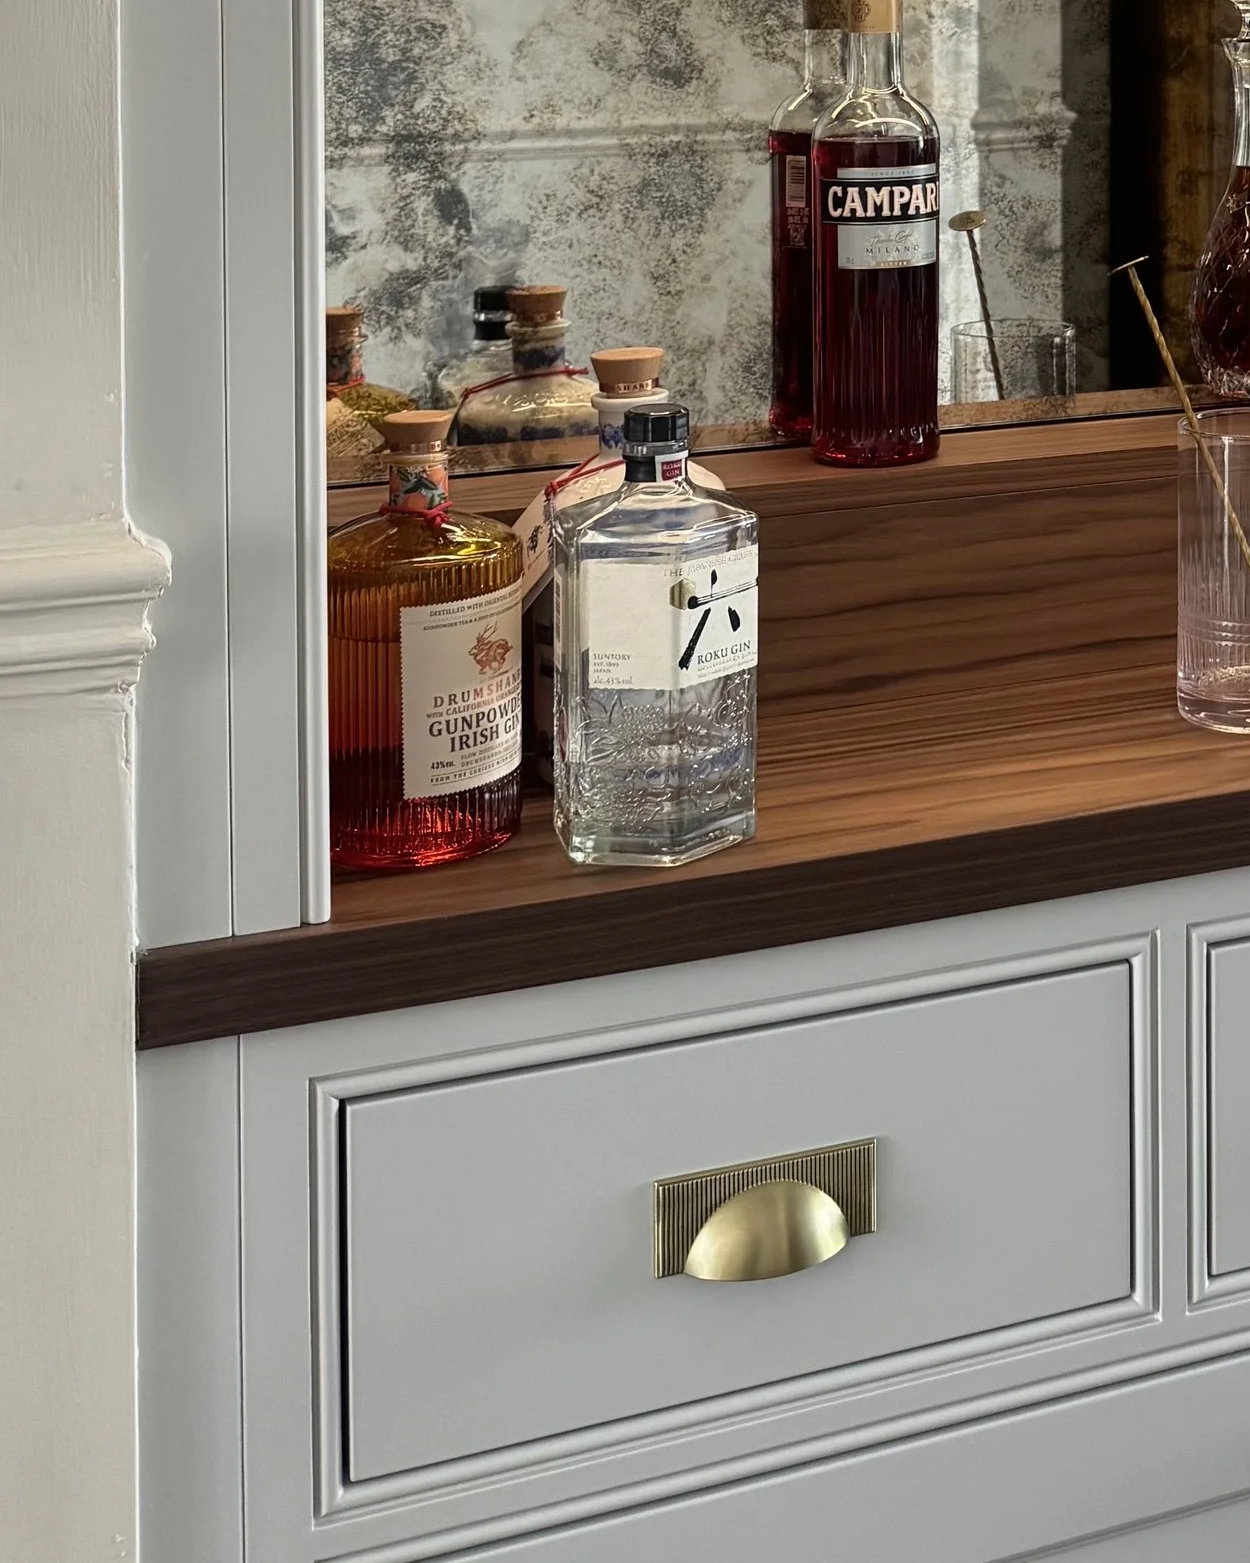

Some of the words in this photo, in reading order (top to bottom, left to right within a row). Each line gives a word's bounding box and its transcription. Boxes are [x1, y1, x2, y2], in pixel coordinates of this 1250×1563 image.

[865, 244, 921, 255] MILANO
[593, 653, 632, 661] SUNTORY
[697, 647, 728, 665] ROKU
[730, 640, 751, 655] GIN
[450, 723, 500, 753] IRISH
